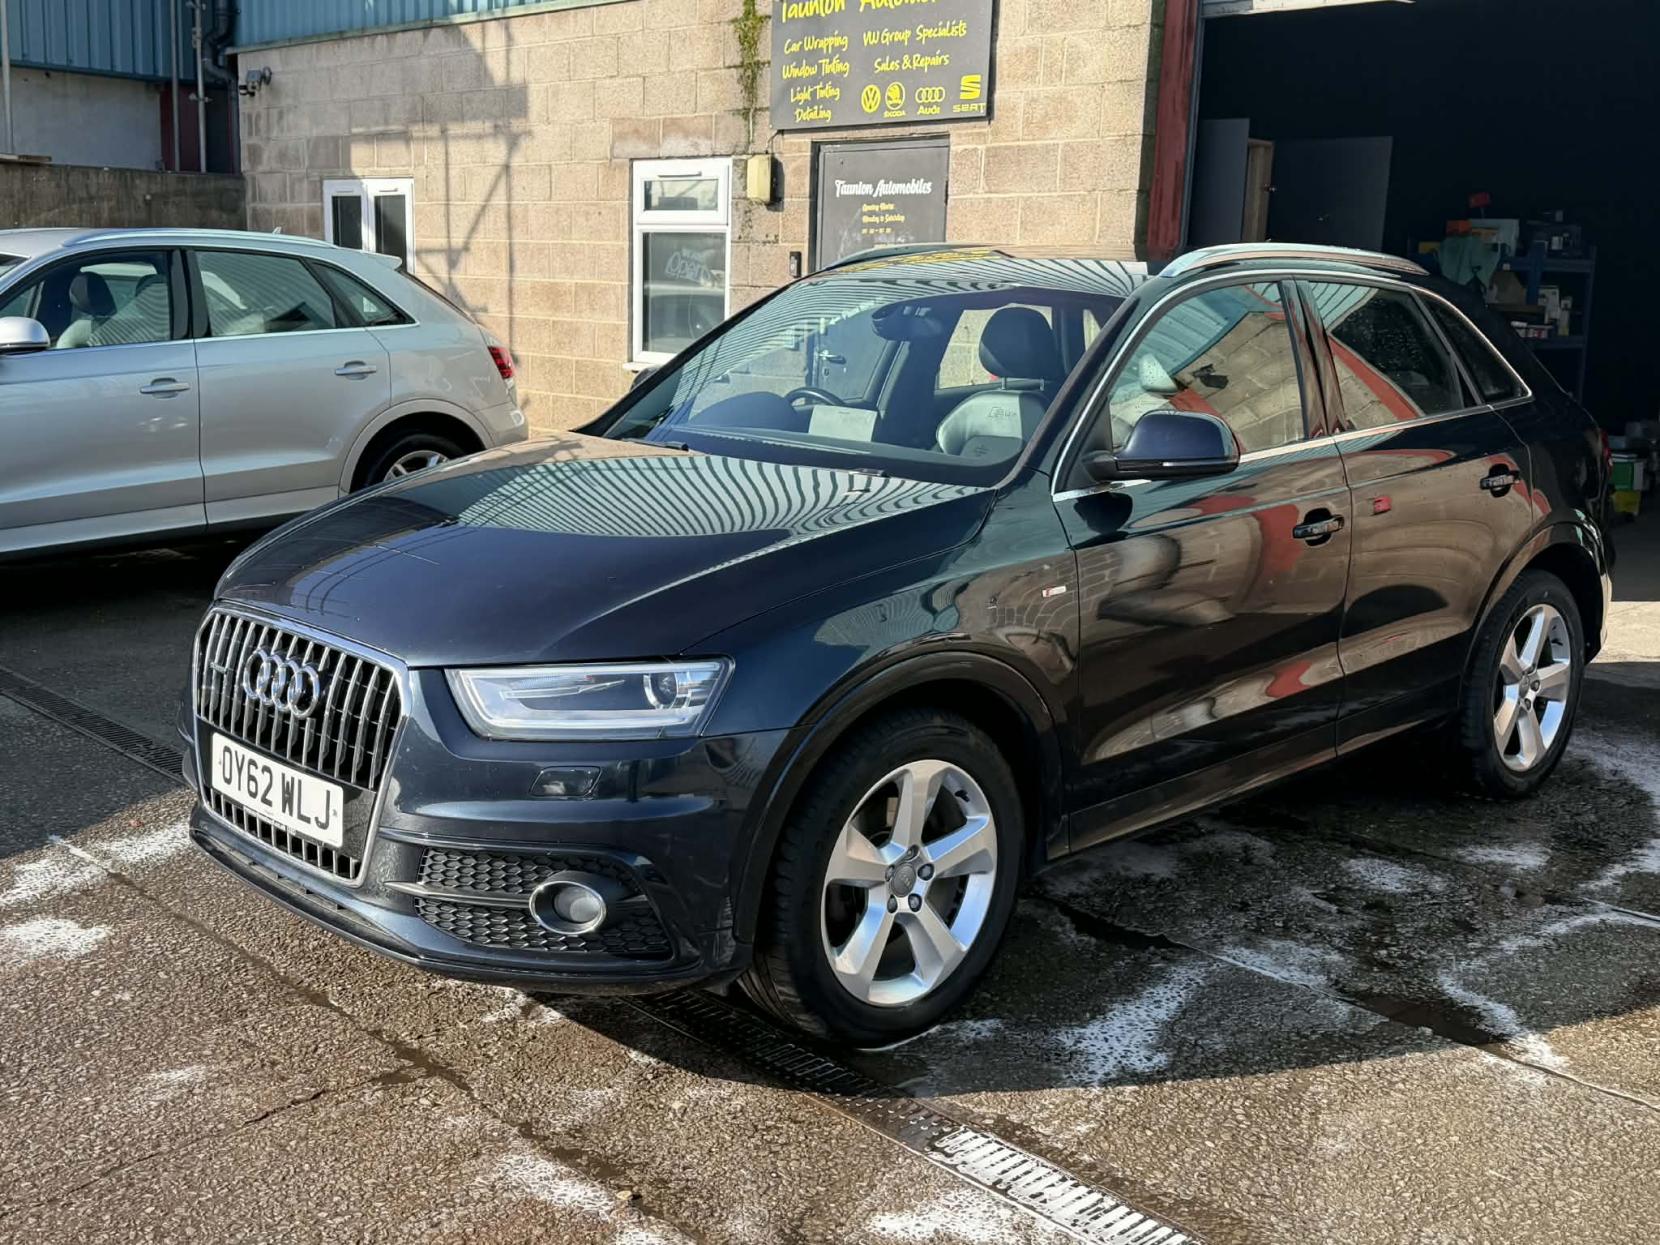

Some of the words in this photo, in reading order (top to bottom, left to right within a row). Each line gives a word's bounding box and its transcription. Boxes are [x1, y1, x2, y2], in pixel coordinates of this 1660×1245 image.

[784, 38, 802, 55] Car
[803, 30, 848, 54] Wrapping
[881, 28, 912, 46] Group
[916, 20, 967, 45] Specialists
[782, 59, 817, 79] Window
[818, 54, 850, 77] Tinting
[874, 56, 900, 73] Sales
[912, 50, 950, 72] Repairs
[790, 85, 812, 105] Light
[812, 80, 840, 101] Tinting
[795, 104, 832, 123] Detailing
[917, 104, 941, 115] Audi
[952, 102, 987, 113] SEAT
[872, 178, 933, 198] Automobiles
[222, 745, 273, 808] OY62
[281, 772, 331, 831] WLJ
